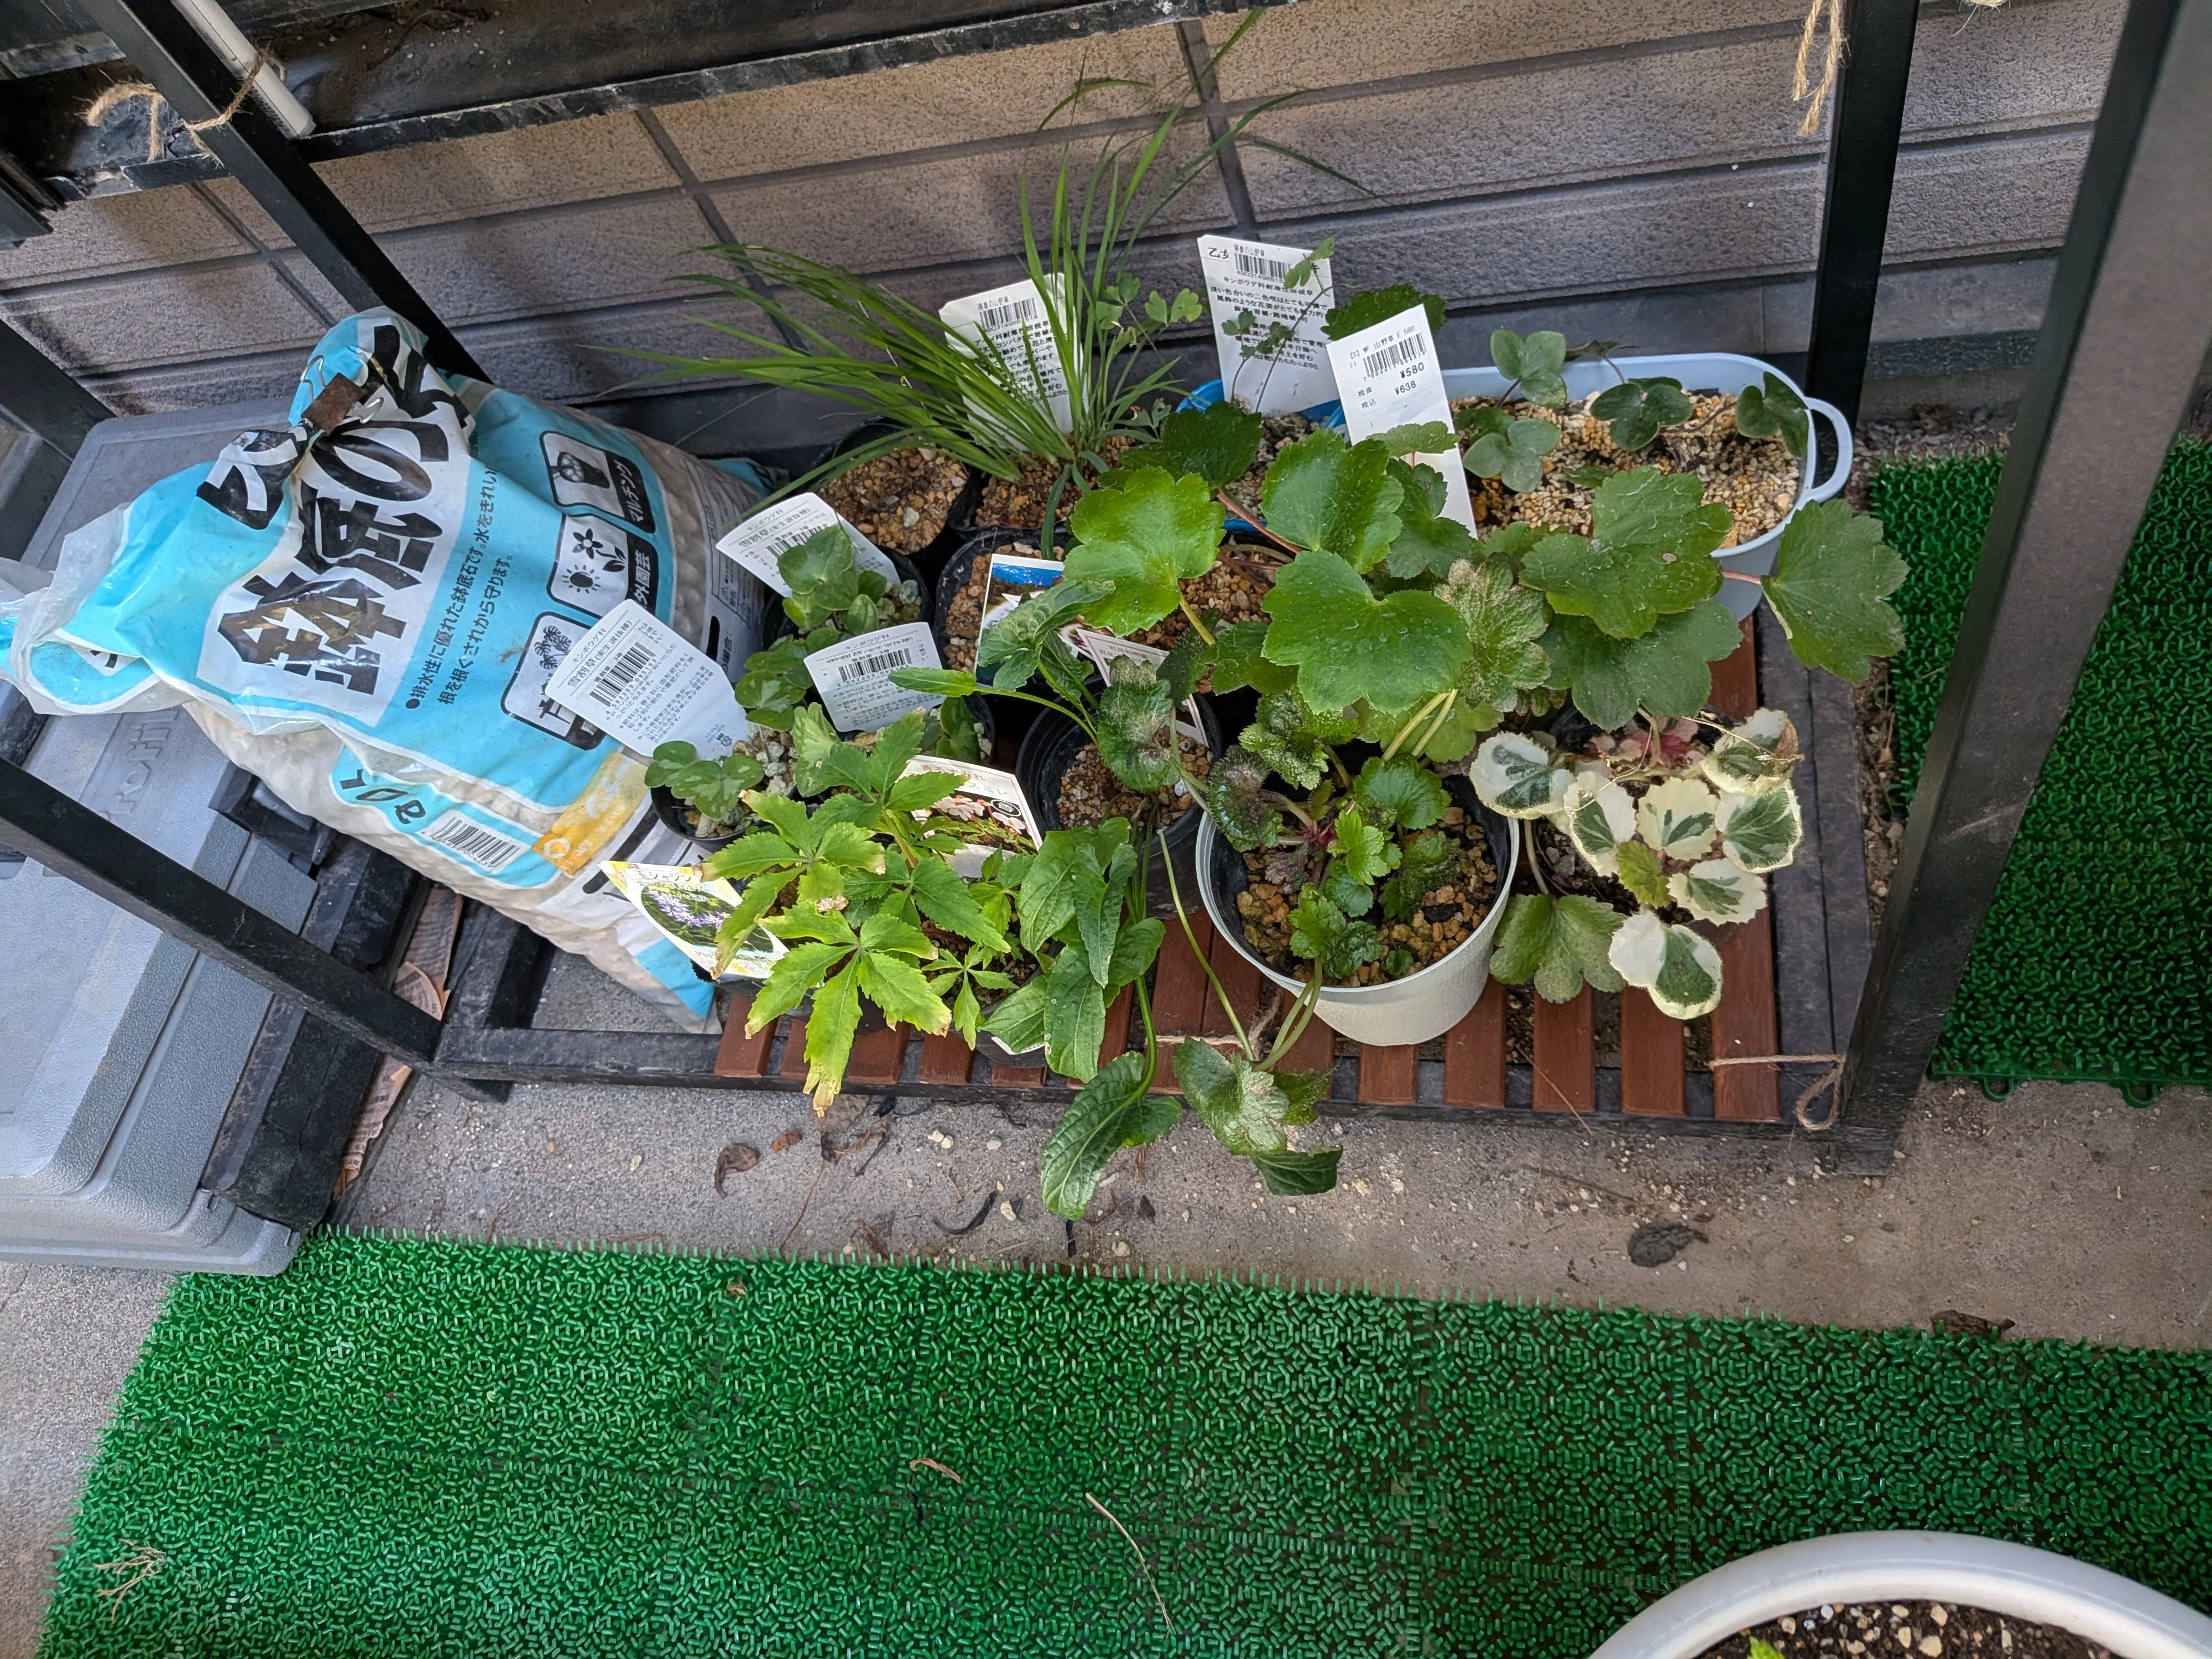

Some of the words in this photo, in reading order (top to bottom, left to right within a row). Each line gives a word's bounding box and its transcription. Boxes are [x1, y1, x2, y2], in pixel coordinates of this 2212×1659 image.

[1403, 325, 1415, 335] 580
[1399, 361, 1425, 379] ¥580
[1394, 379, 1416, 395] ¥638
[613, 463, 644, 521] マルチング
[634, 551, 650, 605] 外園芸
[571, 627, 607, 665] キンポウゲ科
